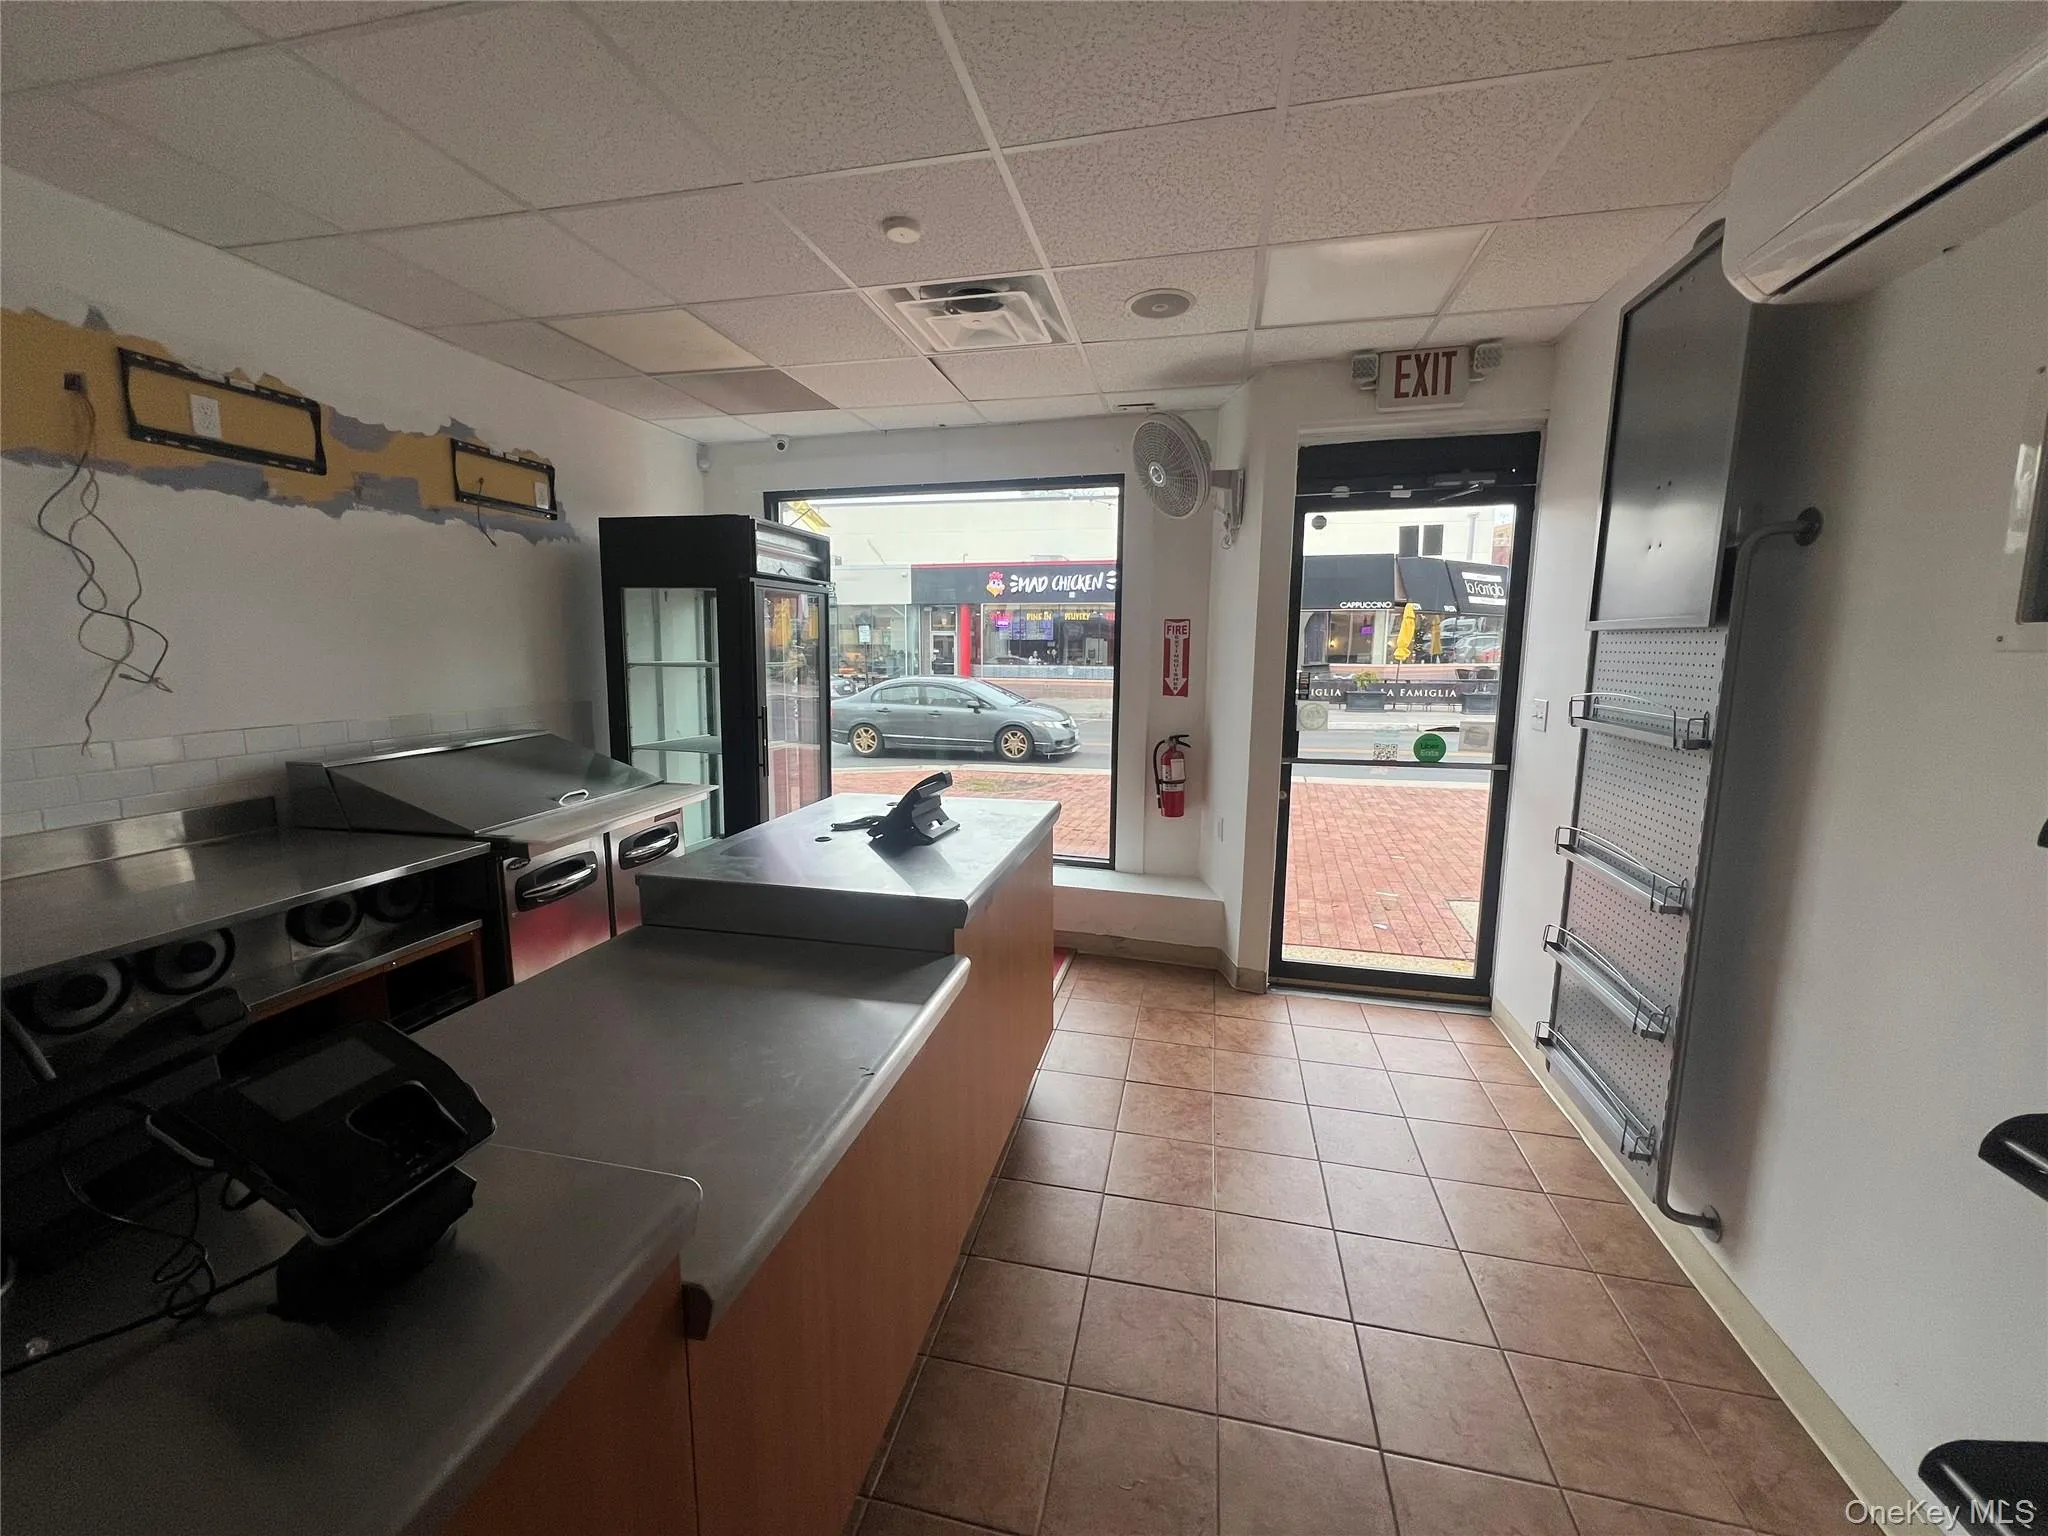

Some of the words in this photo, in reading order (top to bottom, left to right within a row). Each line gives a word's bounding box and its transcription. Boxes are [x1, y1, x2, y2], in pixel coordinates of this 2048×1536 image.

[1394, 351, 1457, 399] EXIT
[1018, 575, 1048, 593] MAD
[1052, 571, 1104, 592] CHICKEN
[1340, 601, 1392, 609] CAPPUCCINO
[1166, 625, 1187, 635] FIRE
[1400, 688, 1457, 698] FAMIGLIA
